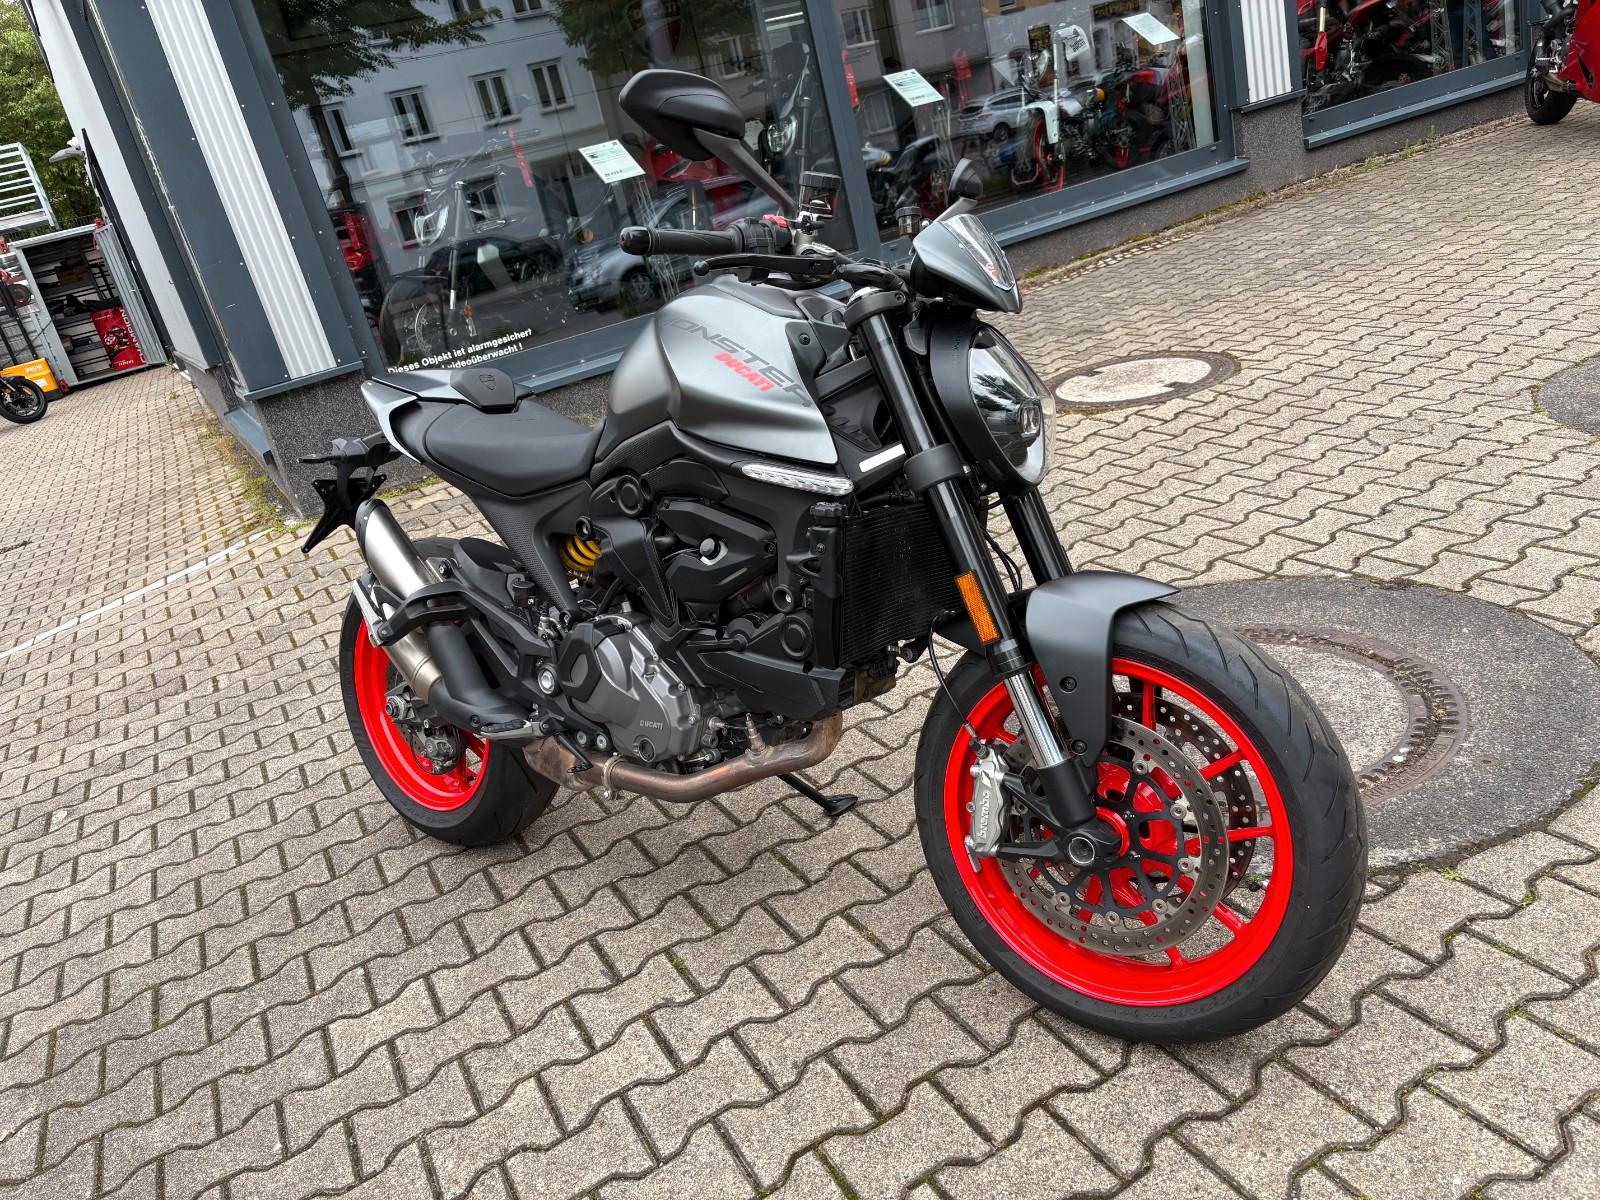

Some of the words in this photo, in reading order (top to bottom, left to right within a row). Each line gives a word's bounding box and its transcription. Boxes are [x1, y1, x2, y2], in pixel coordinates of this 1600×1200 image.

[387, 362, 420, 373] Dieses
[421, 353, 452, 367] Objekt
[453, 348, 466, 357] ist
[467, 328, 532, 353] alarmgesichert
[714, 352, 775, 392] DUCATI
[640, 720, 663, 729] DUCATI
[977, 791, 990, 838] brembo
